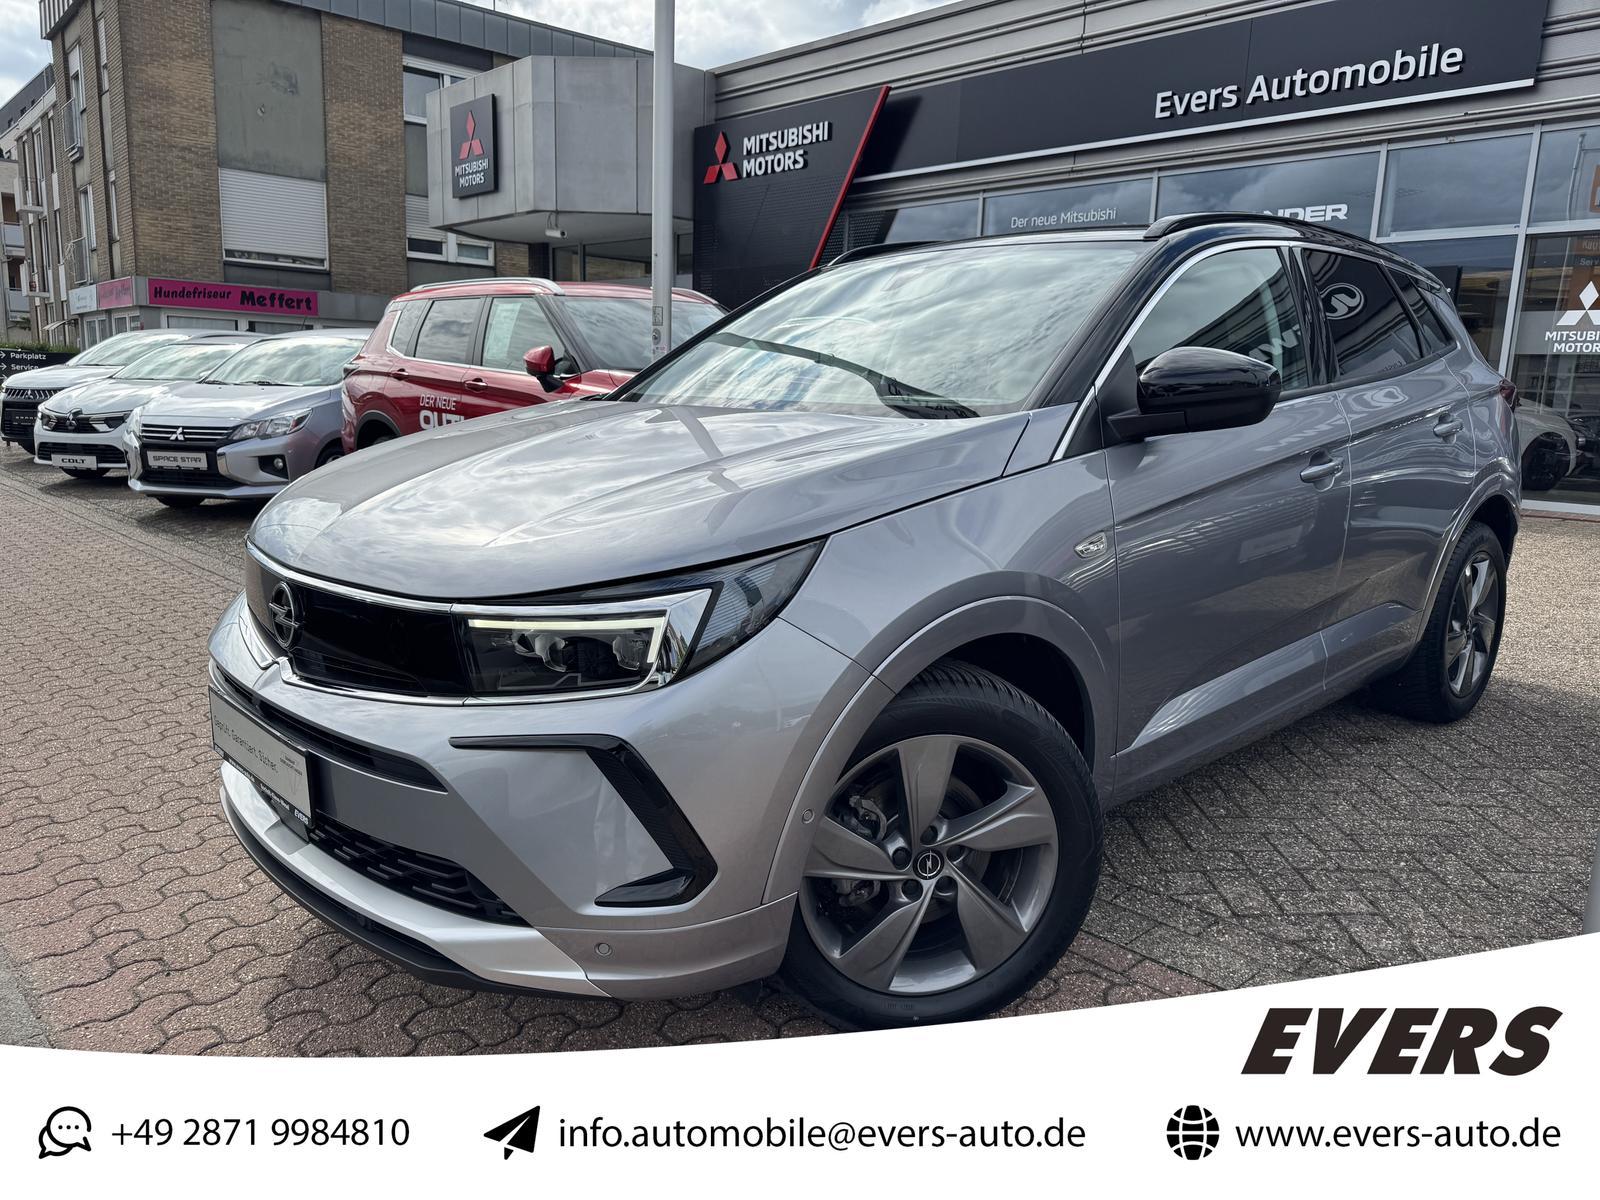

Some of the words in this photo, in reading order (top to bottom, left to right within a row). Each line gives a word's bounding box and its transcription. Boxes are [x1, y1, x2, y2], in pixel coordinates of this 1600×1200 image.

[1154, 84, 1239, 118] Evers
[1246, 43, 1463, 104] Automobile
[743, 121, 829, 155] MITSUBISHI
[454, 158, 489, 176] MITSUBISHI
[742, 149, 805, 178] MOTORS
[459, 172, 485, 187] MOTORS
[1010, 216, 1028, 228] Der
[1031, 215, 1057, 226] neue
[1060, 207, 1117, 225] Mitsubishi
[153, 286, 231, 300] Hundefriseur
[239, 290, 312, 311] Meffert
[10, 352, 47, 360] Parkplatz
[419, 394, 435, 408] DER
[435, 395, 457, 410] NEUE
[152, 455, 179, 463] SPACE
